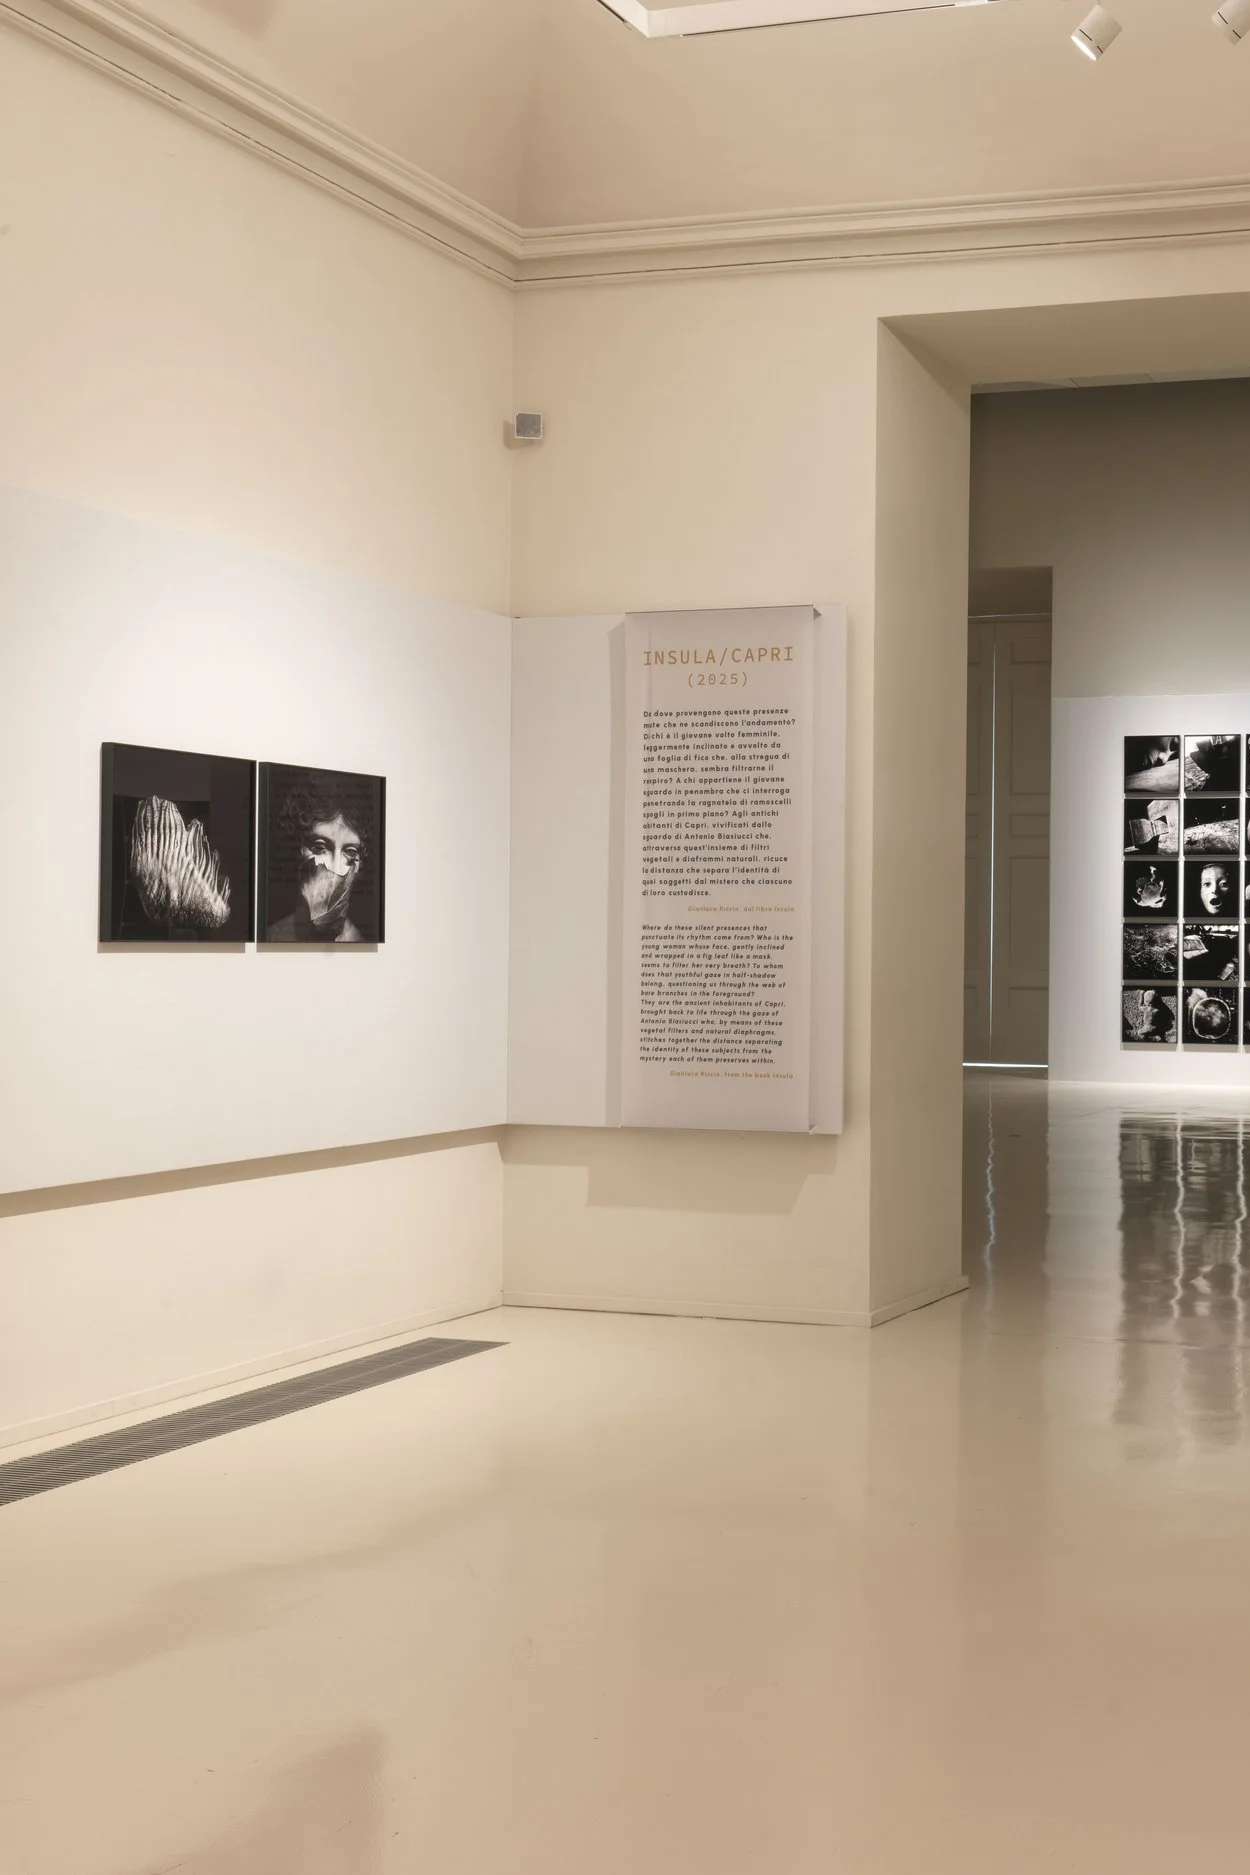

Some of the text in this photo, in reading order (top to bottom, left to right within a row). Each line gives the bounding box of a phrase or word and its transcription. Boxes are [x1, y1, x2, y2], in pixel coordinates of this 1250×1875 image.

[643, 646, 794, 666] INSULA/CAPRI
[688, 672, 748, 688] (2025)
[732, 810, 748, 819] Agli
